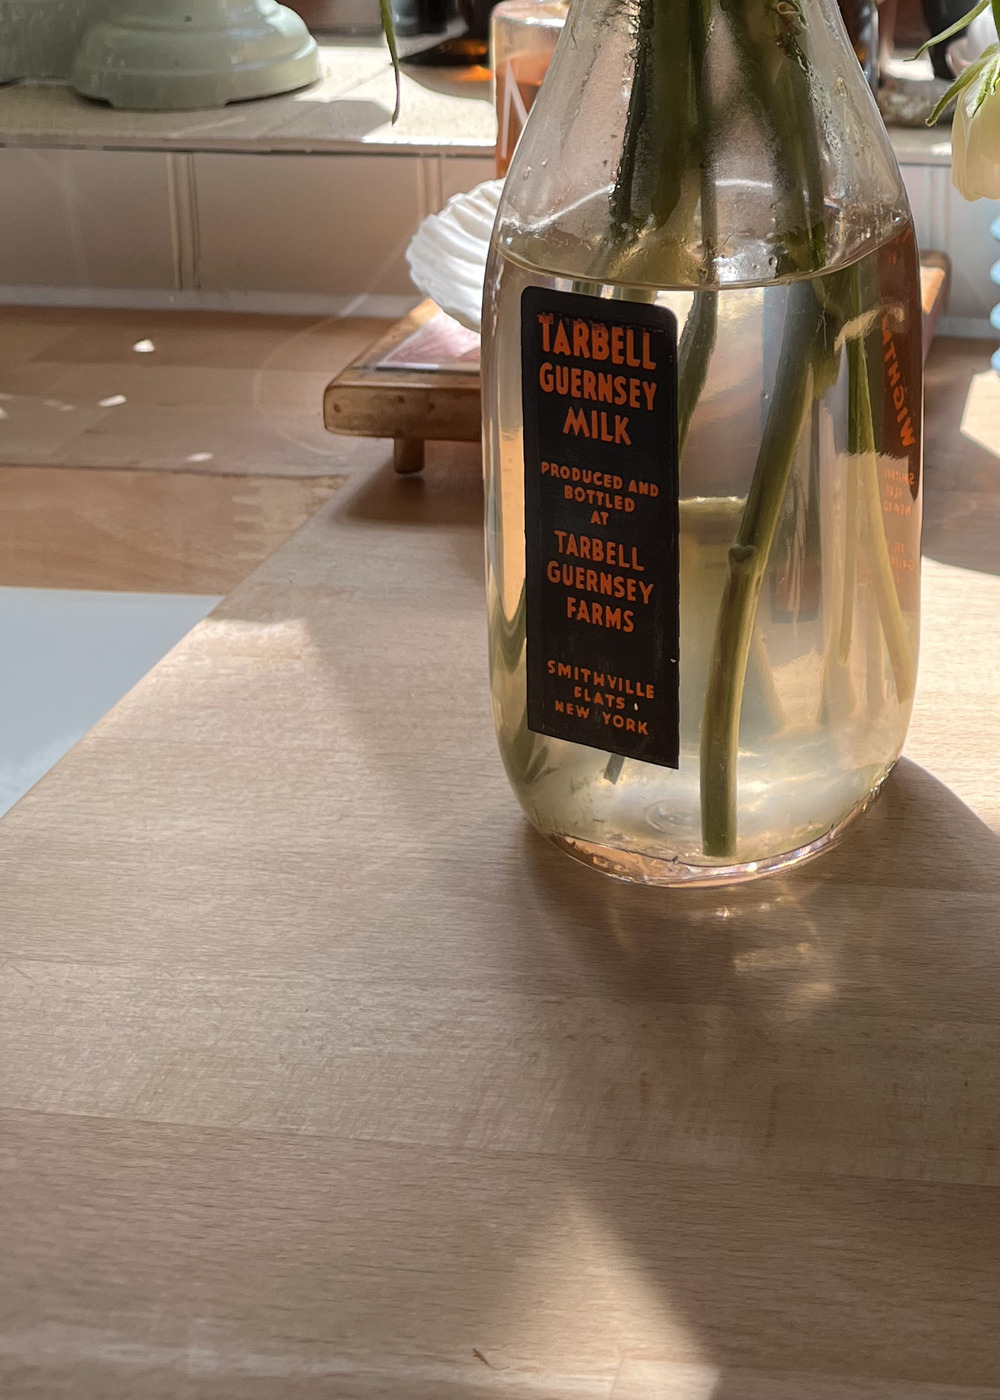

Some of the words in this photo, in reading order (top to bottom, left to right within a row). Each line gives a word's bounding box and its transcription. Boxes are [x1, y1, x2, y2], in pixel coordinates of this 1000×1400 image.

[537, 313, 657, 371] TARBELL
[539, 362, 657, 411] GUERNSEY
[563, 407, 632, 446] MILK
[541, 461, 623, 490] PRODUCED
[628, 479, 659, 497] AND
[564, 485, 636, 513] BOTTLED
[590, 511, 609, 526] AT
[553, 529, 645, 572] TARBELL
[546, 560, 654, 605] GUERNSEY
[566, 596, 635, 633] FARMS
[547, 660, 655, 700] SMITHVILLE
[555, 700, 590, 720] NEW
[602, 711, 649, 736] YORK
